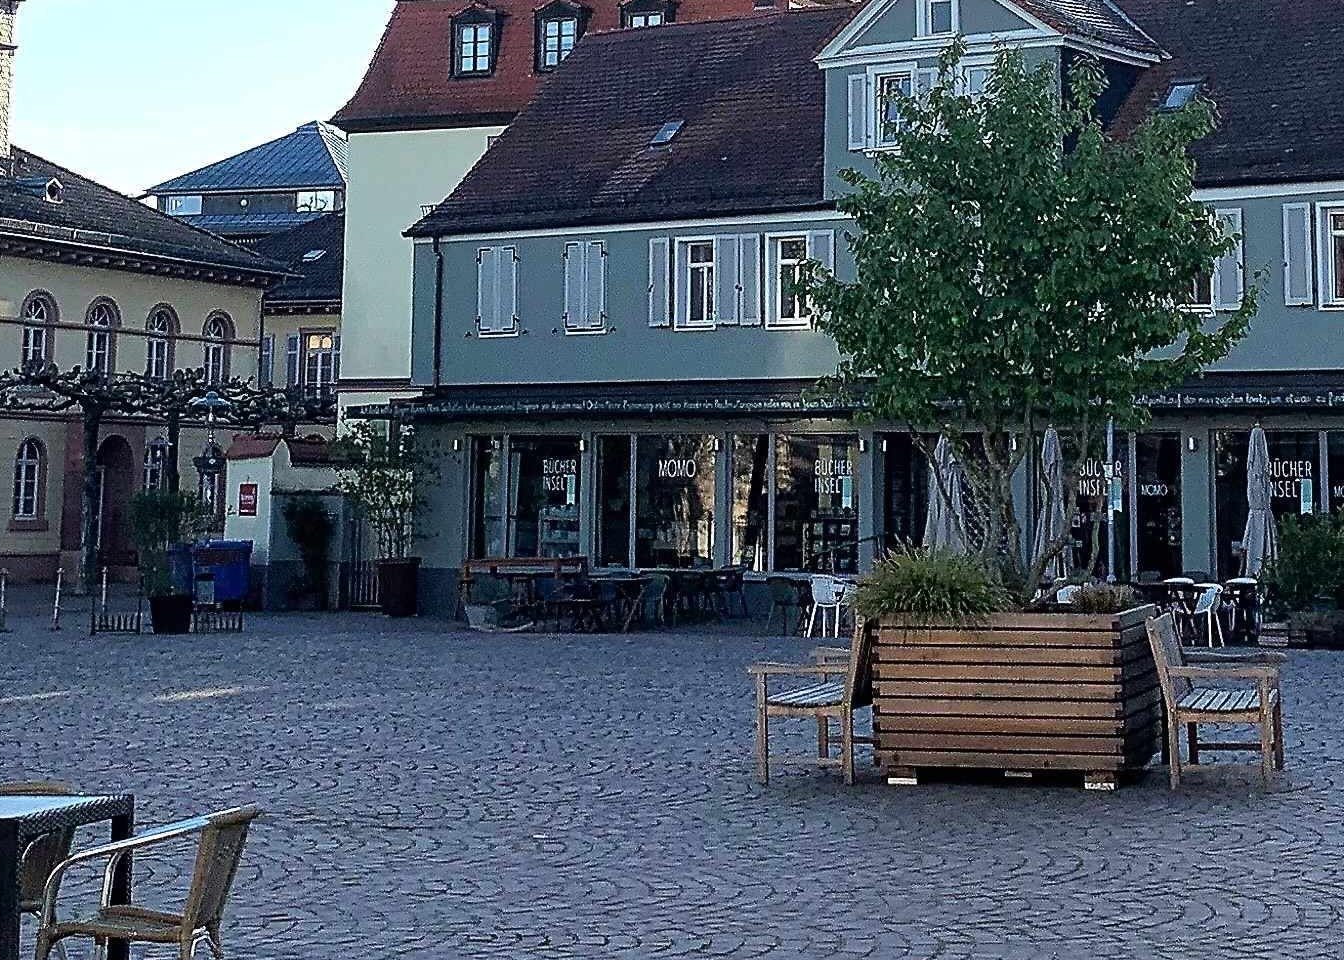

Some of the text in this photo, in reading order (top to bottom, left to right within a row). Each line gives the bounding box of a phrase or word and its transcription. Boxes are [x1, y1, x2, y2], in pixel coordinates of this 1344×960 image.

[543, 457, 577, 474] BÜCHER
[658, 459, 696, 477] MOMO
[815, 457, 853, 475] BÜCHER
[543, 475, 565, 491] INSEL
[815, 477, 841, 493] INSEL
[1141, 483, 1169, 497] MOMO
[1270, 480, 1299, 498] NSEL
